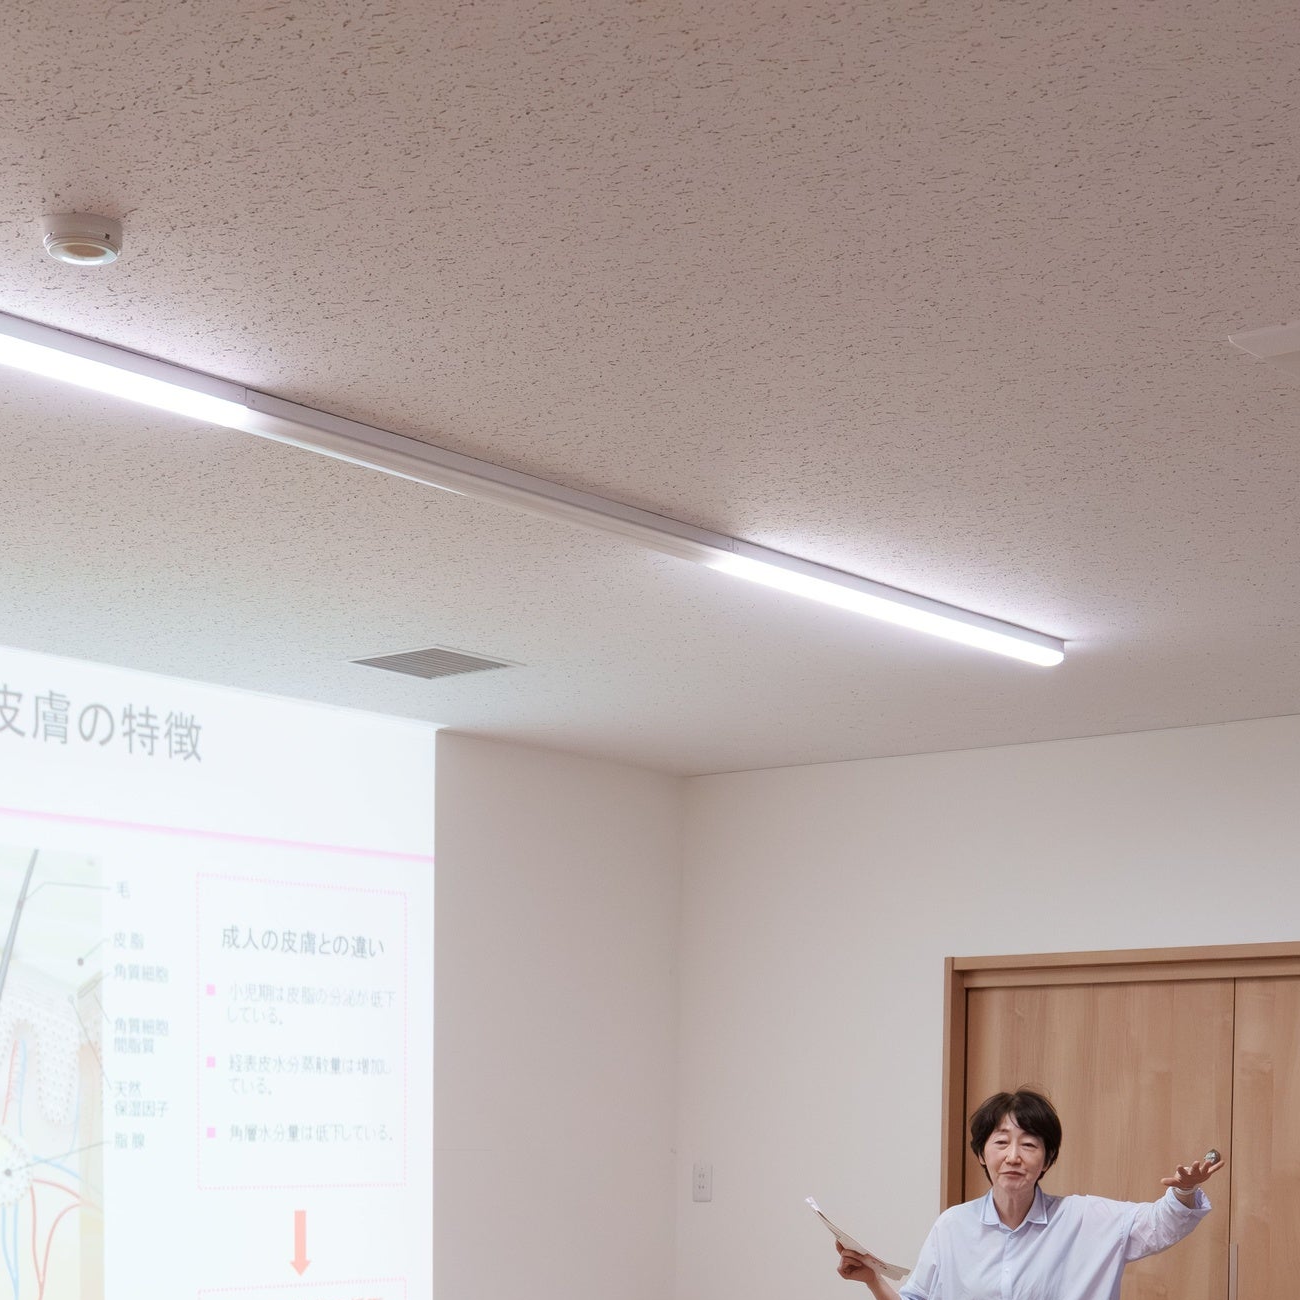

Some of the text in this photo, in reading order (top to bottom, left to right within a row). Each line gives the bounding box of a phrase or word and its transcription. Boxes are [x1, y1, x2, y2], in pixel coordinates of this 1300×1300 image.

[116, 881, 131, 899] 毛
[221, 924, 385, 959] 成人の皮膚との違い
[113, 963, 170, 984] 角質細胞
[114, 1016, 170, 1037] 角質細胞
[114, 1037, 156, 1056] 間脂質
[114, 1081, 143, 1099] 天然
[114, 1100, 170, 1119] 保湿因子
